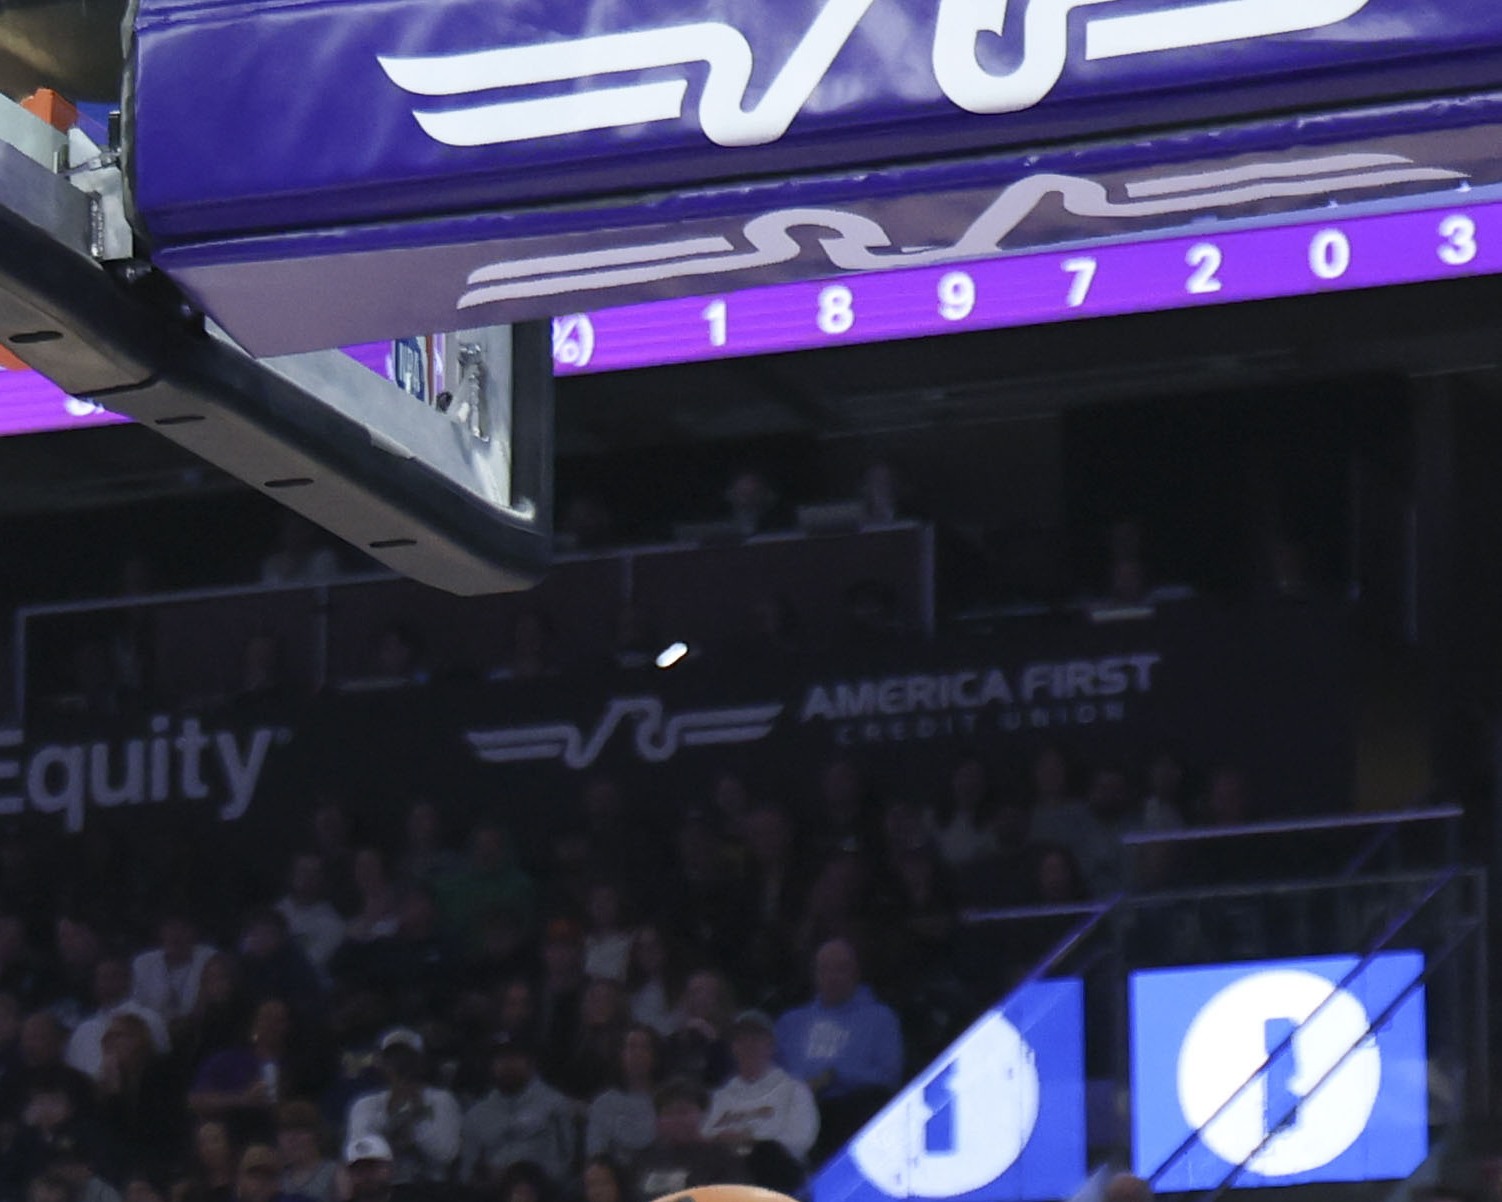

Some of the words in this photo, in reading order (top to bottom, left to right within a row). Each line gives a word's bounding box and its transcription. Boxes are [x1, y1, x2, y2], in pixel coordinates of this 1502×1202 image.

[704, 299, 727, 347] 1
[816, 285, 854, 335] 8
[937, 271, 975, 321] 9
[1063, 257, 1097, 307] 7
[1187, 243, 1222, 294] 2
[1309, 229, 1350, 279] 0
[1438, 215, 1477, 265] 3
[801, 666, 1017, 723] AMERICA
[1020, 652, 1162, 703] FIRST
